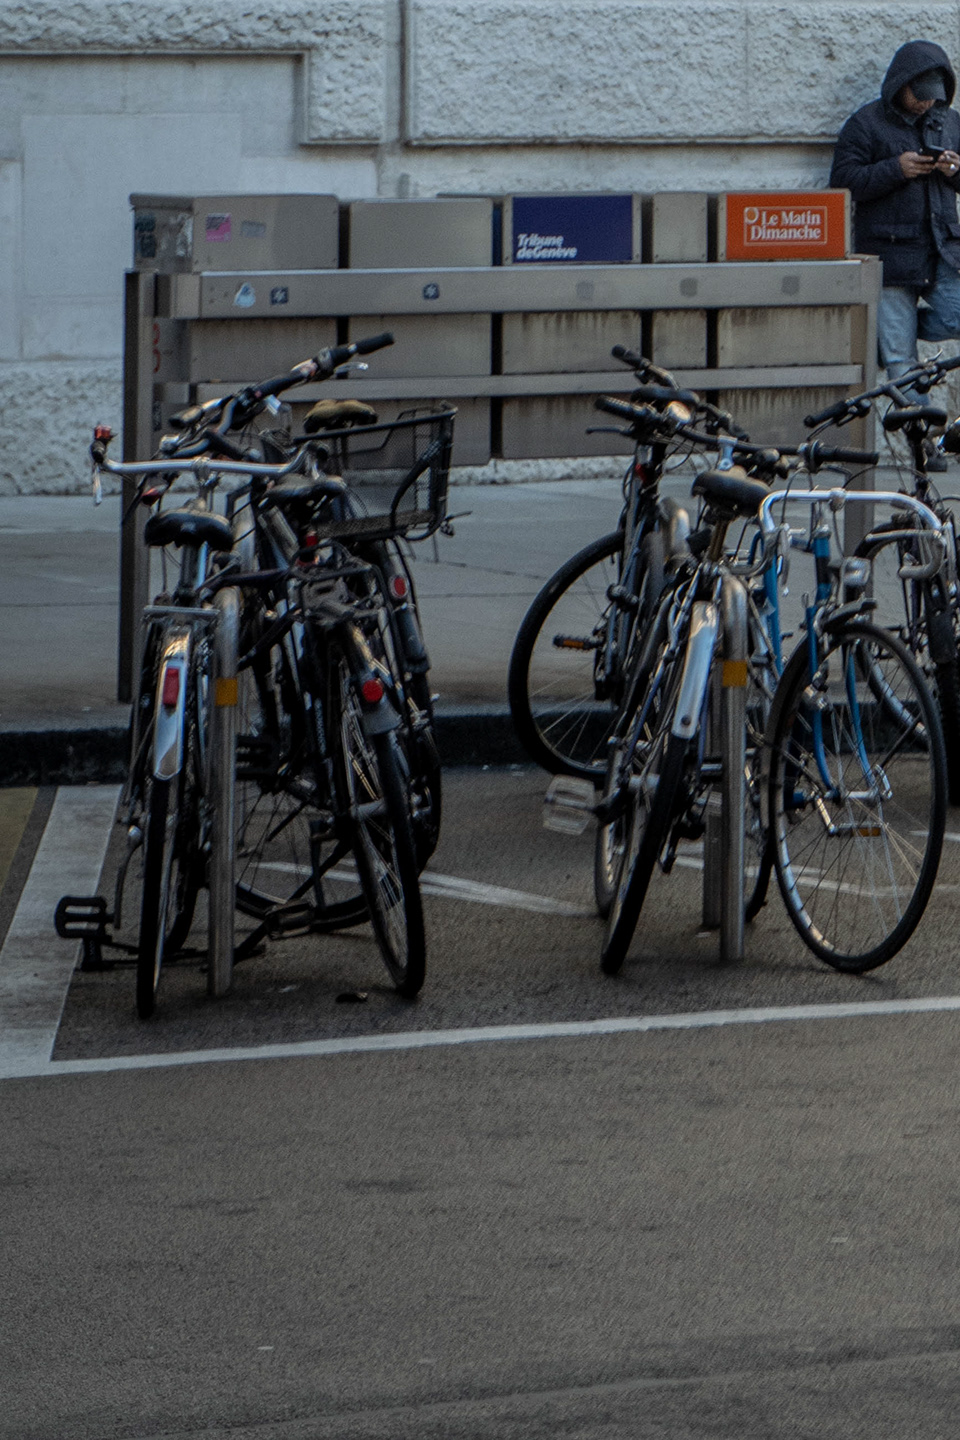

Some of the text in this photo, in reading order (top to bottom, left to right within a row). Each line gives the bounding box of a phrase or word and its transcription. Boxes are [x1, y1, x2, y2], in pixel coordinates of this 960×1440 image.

[761, 210, 822, 226] Le Matin
[517, 233, 565, 248] Tribune
[750, 225, 822, 241] Dimanche
